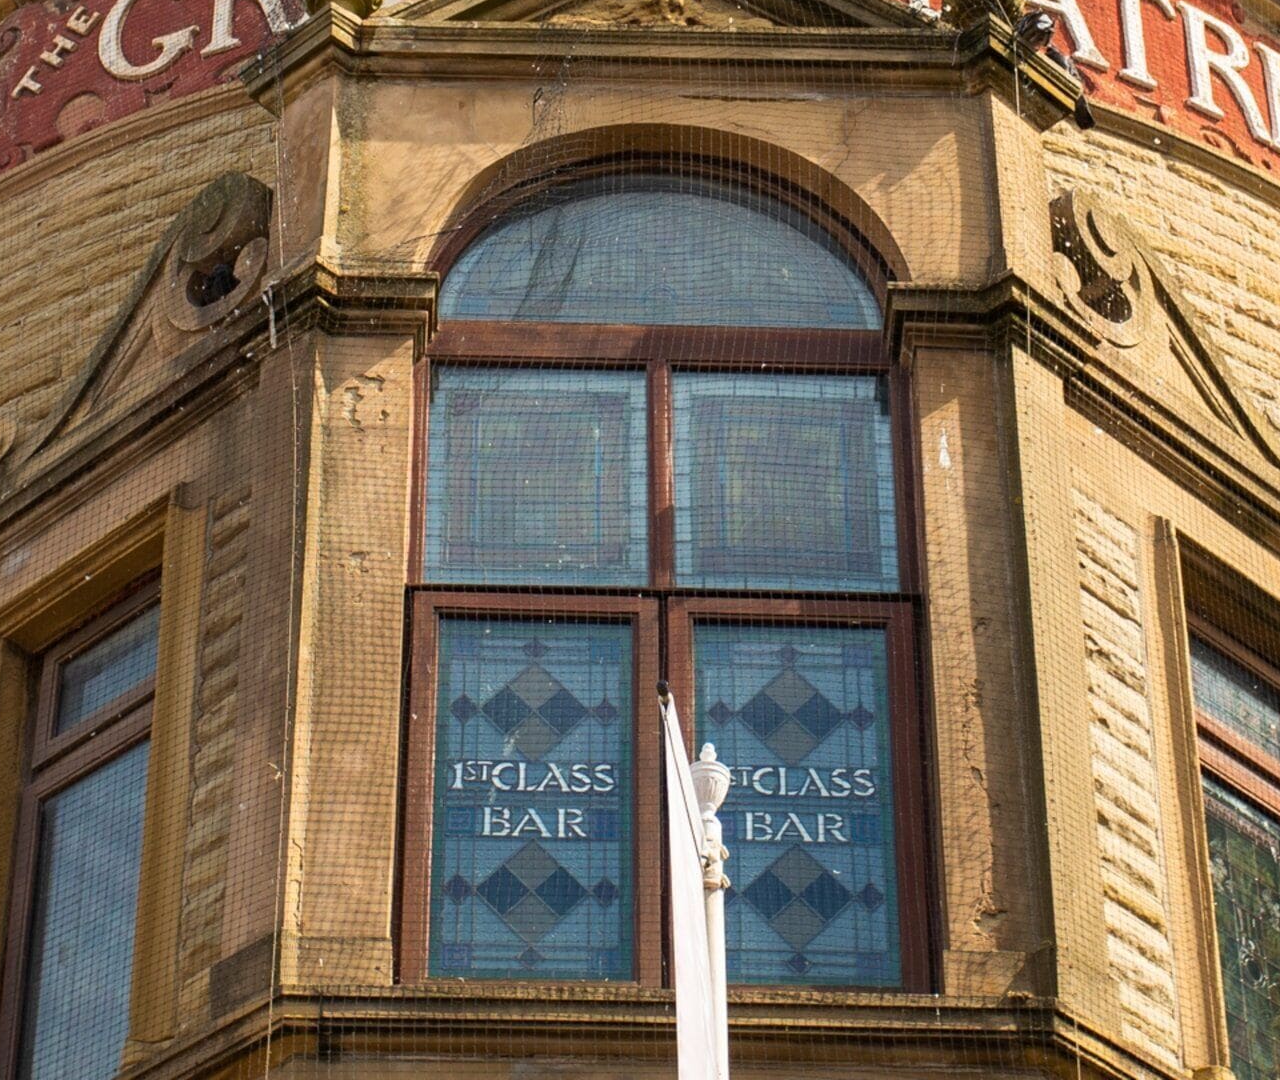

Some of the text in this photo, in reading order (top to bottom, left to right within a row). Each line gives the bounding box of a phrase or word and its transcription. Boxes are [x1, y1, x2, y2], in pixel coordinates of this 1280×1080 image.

[11, 5, 101, 100] THE
[491, 762, 615, 793] CLASS
[729, 766, 876, 797] ST CLASS
[482, 806, 587, 838] BAR
[745, 812, 850, 842] BAR
